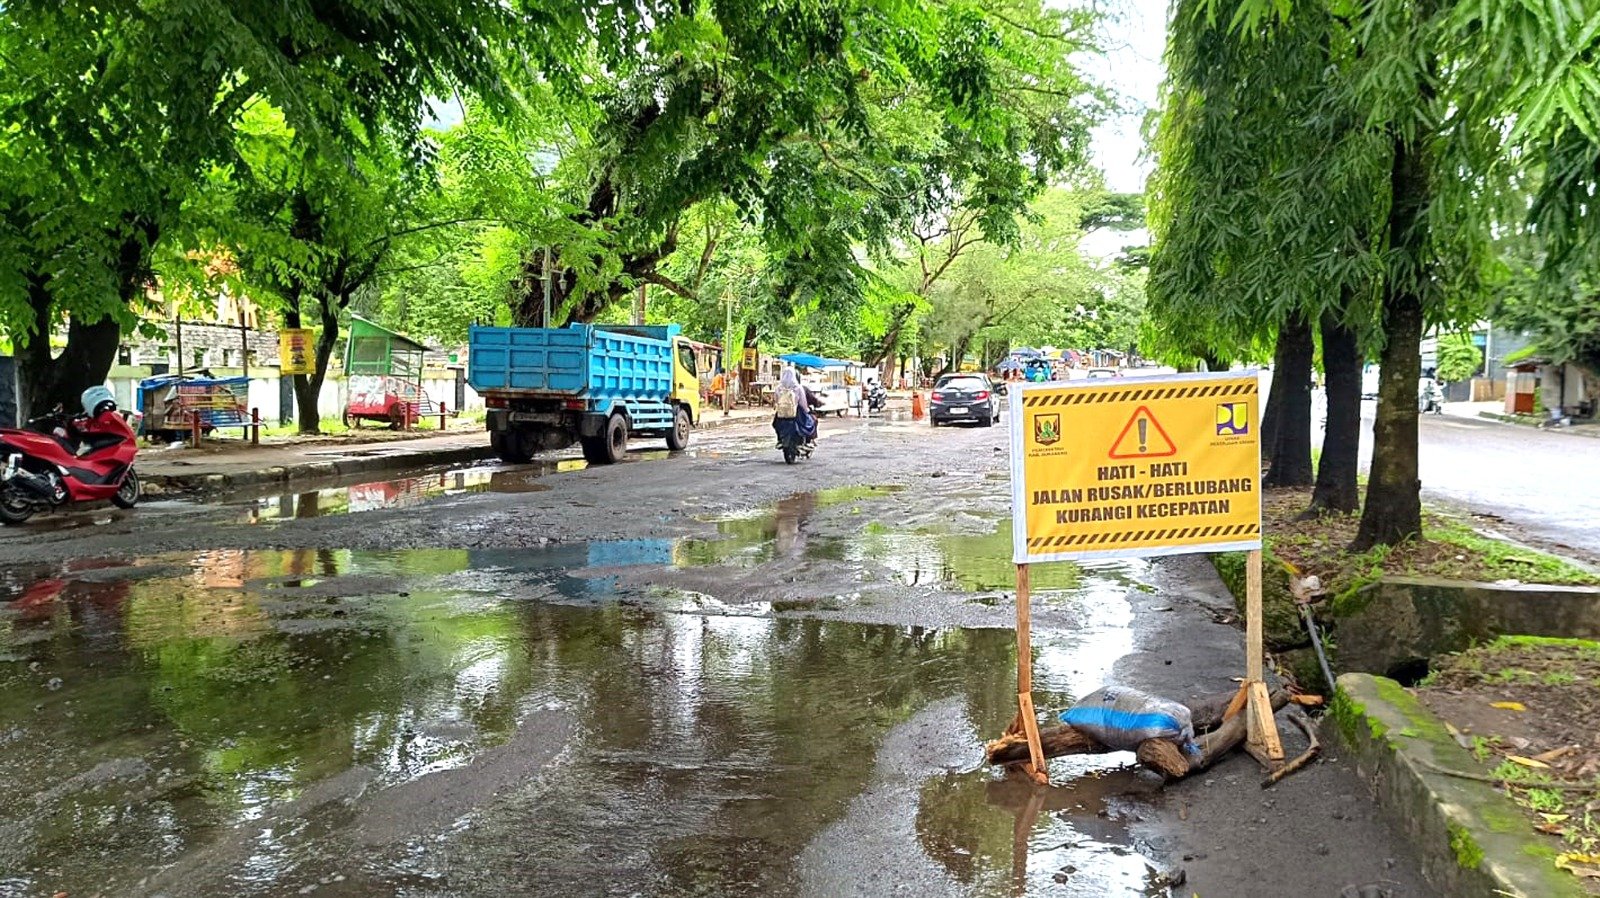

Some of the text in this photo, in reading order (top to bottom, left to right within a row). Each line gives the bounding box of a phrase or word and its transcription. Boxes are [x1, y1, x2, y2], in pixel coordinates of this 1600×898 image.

[1097, 465, 1135, 481] HATI
[1150, 462, 1188, 478] HATI
[1032, 478, 1252, 505] JALAN RUSAK/BERLUBANG
[1056, 499, 1230, 524] KURANGI KECEPATAN
